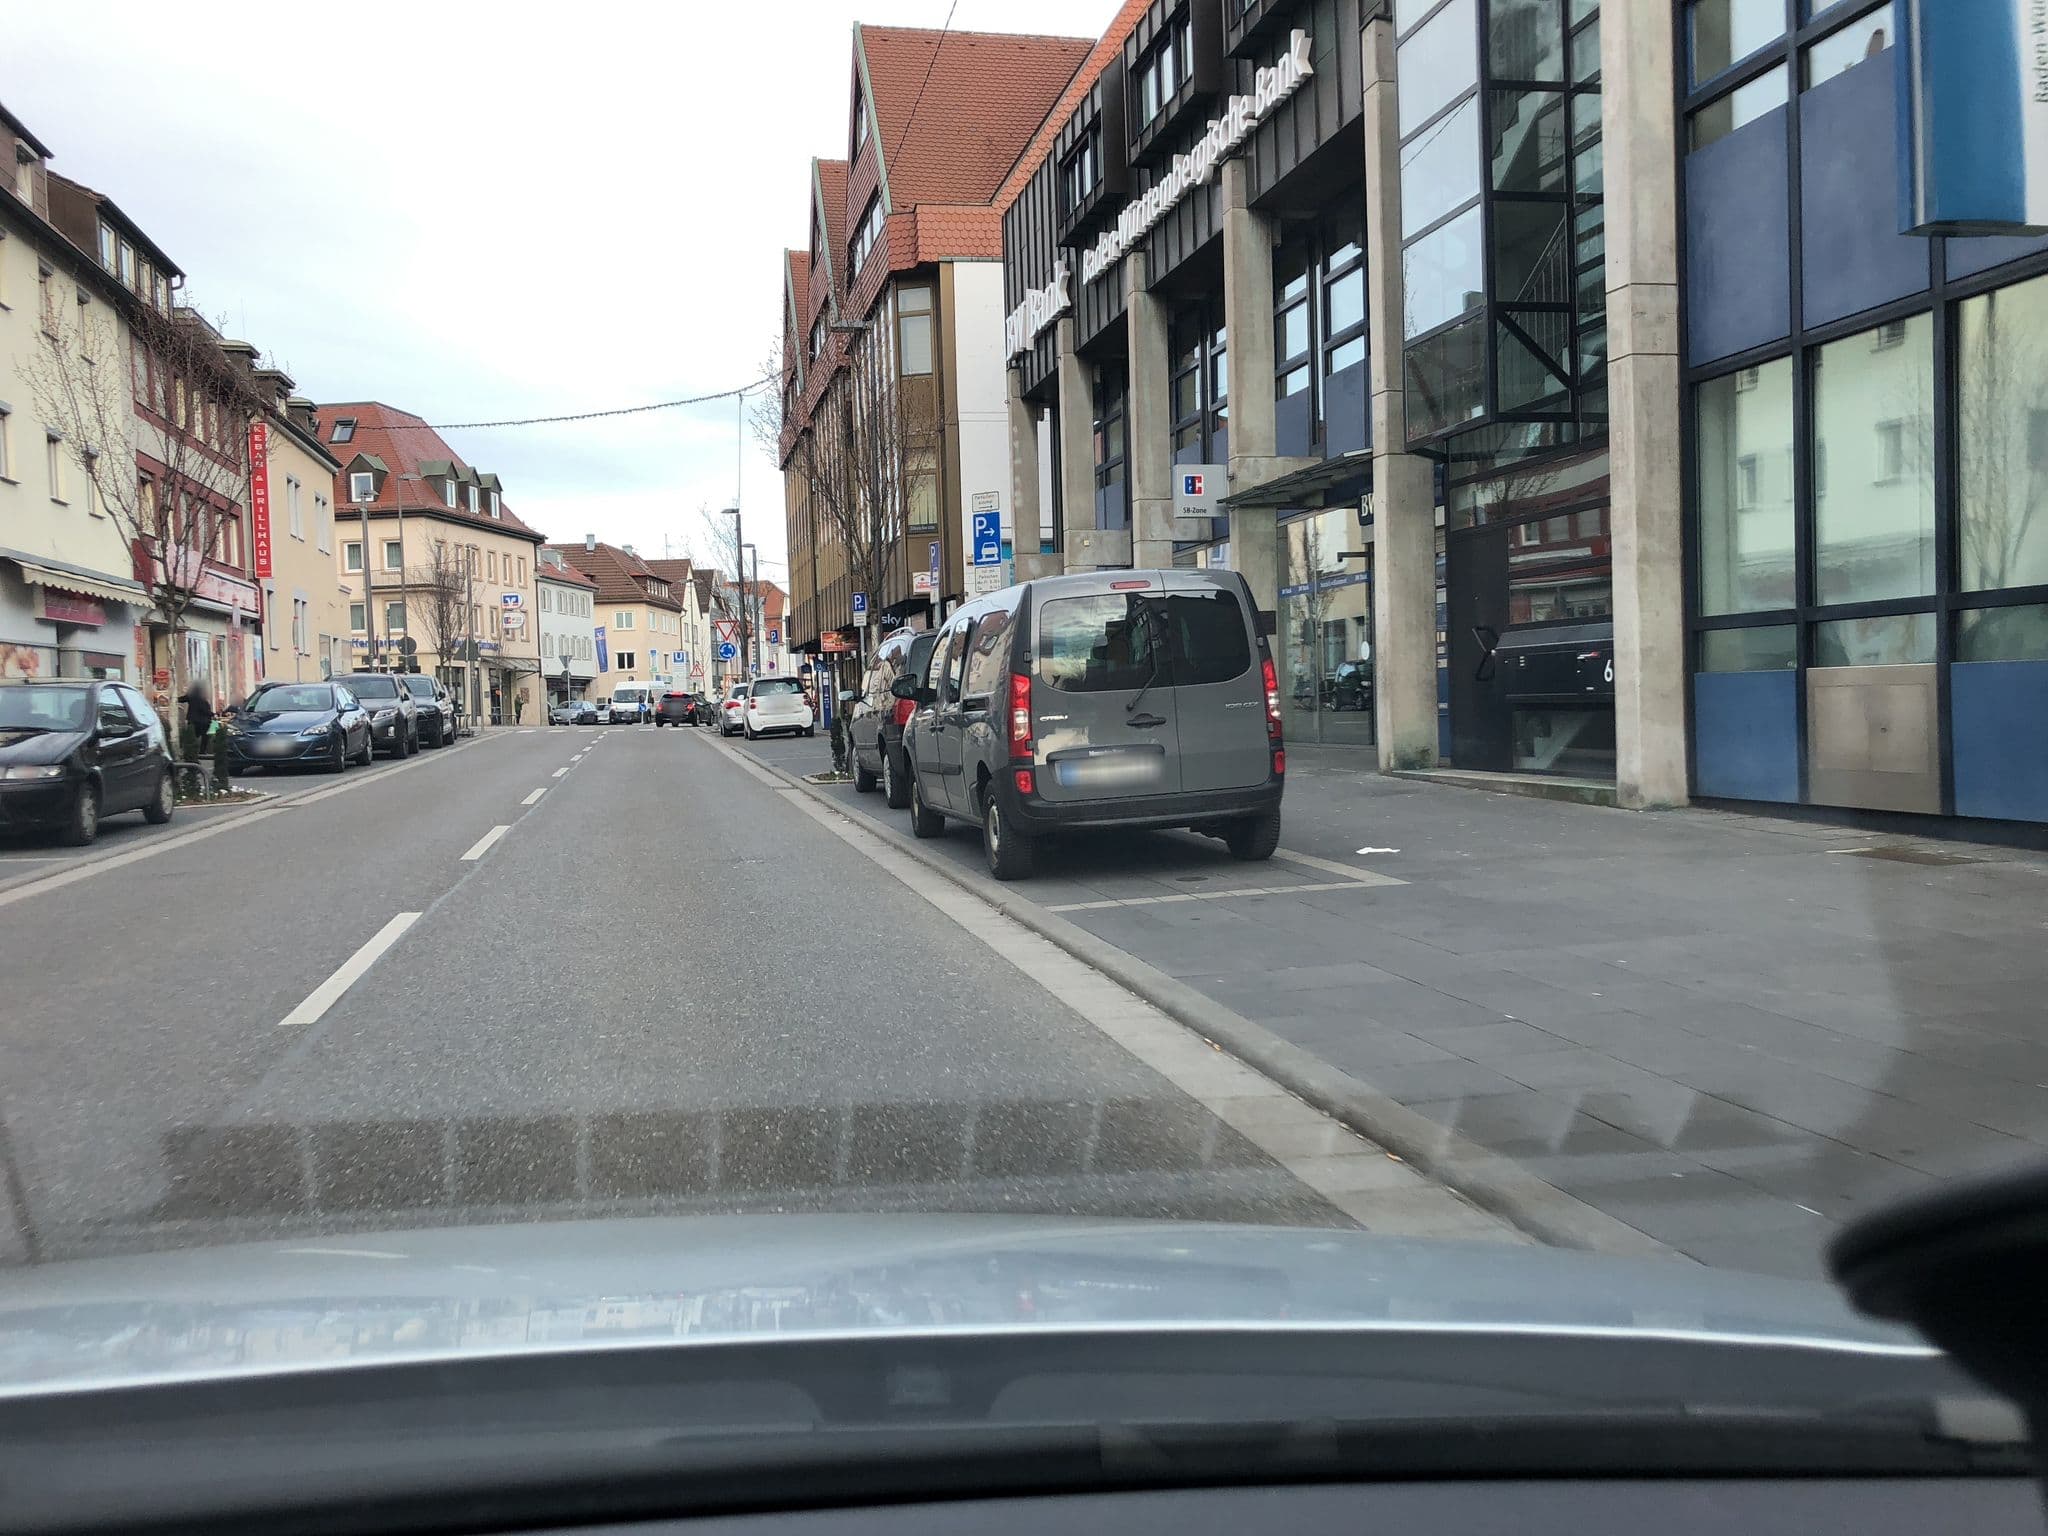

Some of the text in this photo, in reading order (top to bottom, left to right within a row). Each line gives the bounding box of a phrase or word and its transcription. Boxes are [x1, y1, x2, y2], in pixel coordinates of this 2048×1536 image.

[1256, 29, 1314, 118] Bank
[1026, 260, 1071, 337] Bank
[1183, 506, 1207, 514] SB-Zone
[256, 488, 267, 565] GRILLHAUS
[975, 516, 987, 538] P
[854, 594, 862, 610] P
[881, 613, 901, 626] sky
[674, 651, 684, 661] U
[1604, 659, 1613, 682] 6
